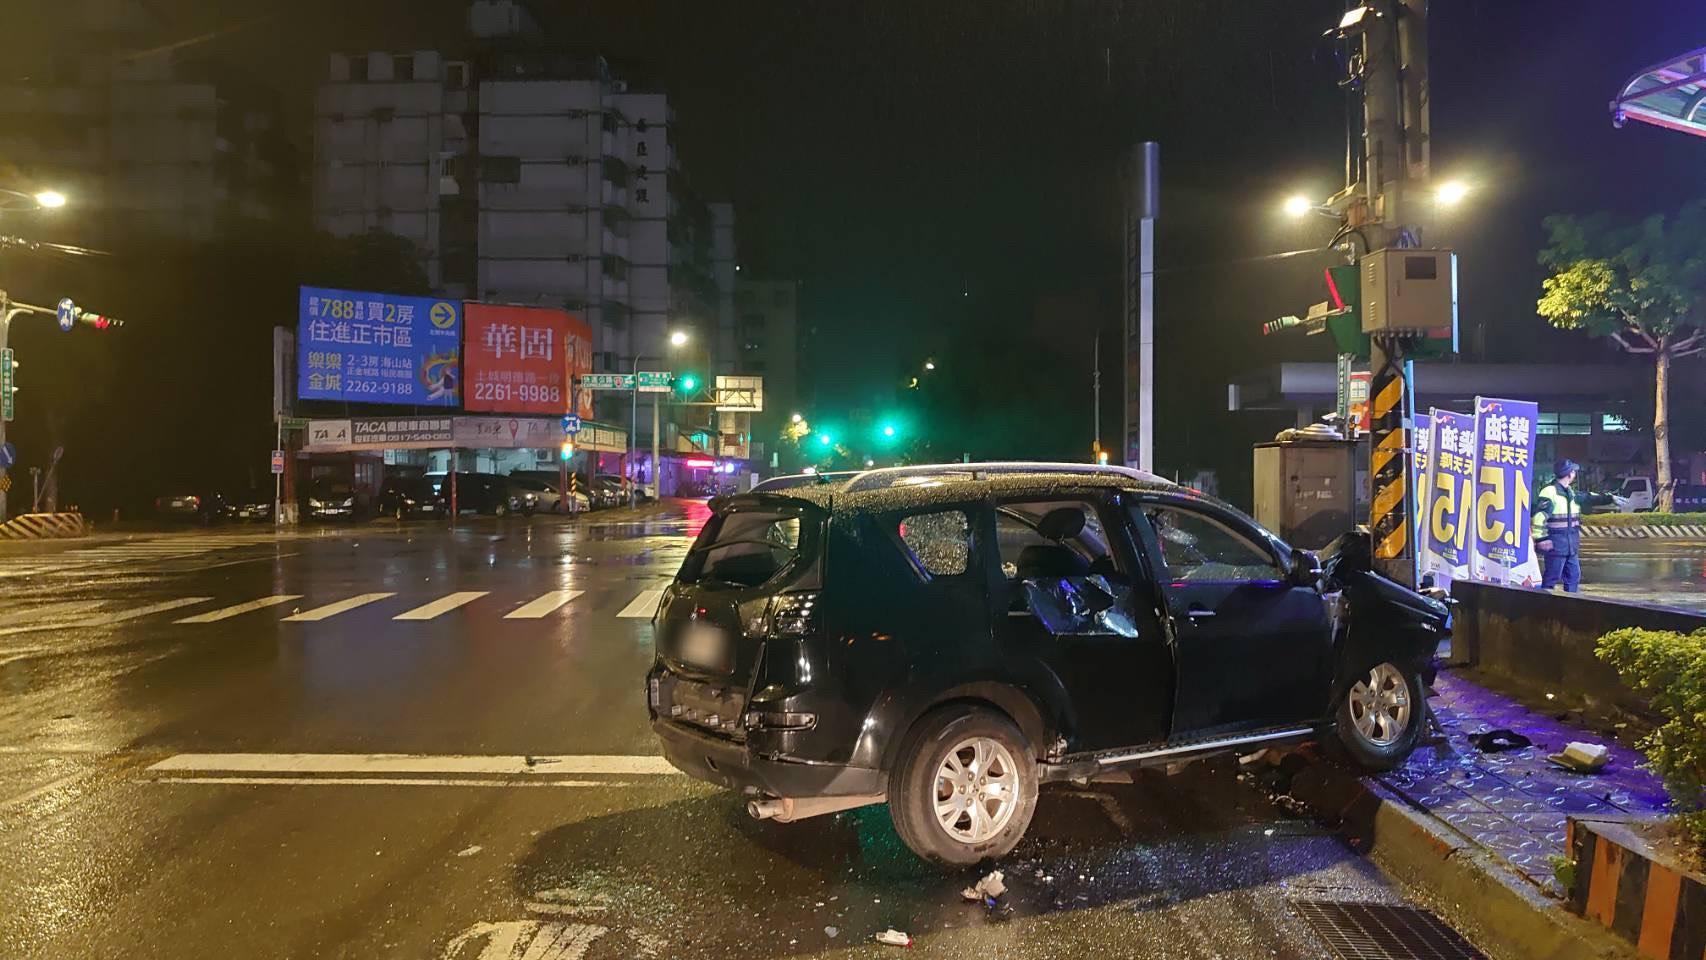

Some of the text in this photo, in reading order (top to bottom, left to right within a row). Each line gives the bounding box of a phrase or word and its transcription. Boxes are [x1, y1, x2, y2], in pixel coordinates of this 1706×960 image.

[320, 299, 354, 319] 788
[308, 320, 413, 347] 住進正市區
[308, 372, 342, 391] 金城
[346, 380, 412, 395] 2262-9188
[475, 383, 560, 402] 2261-9988
